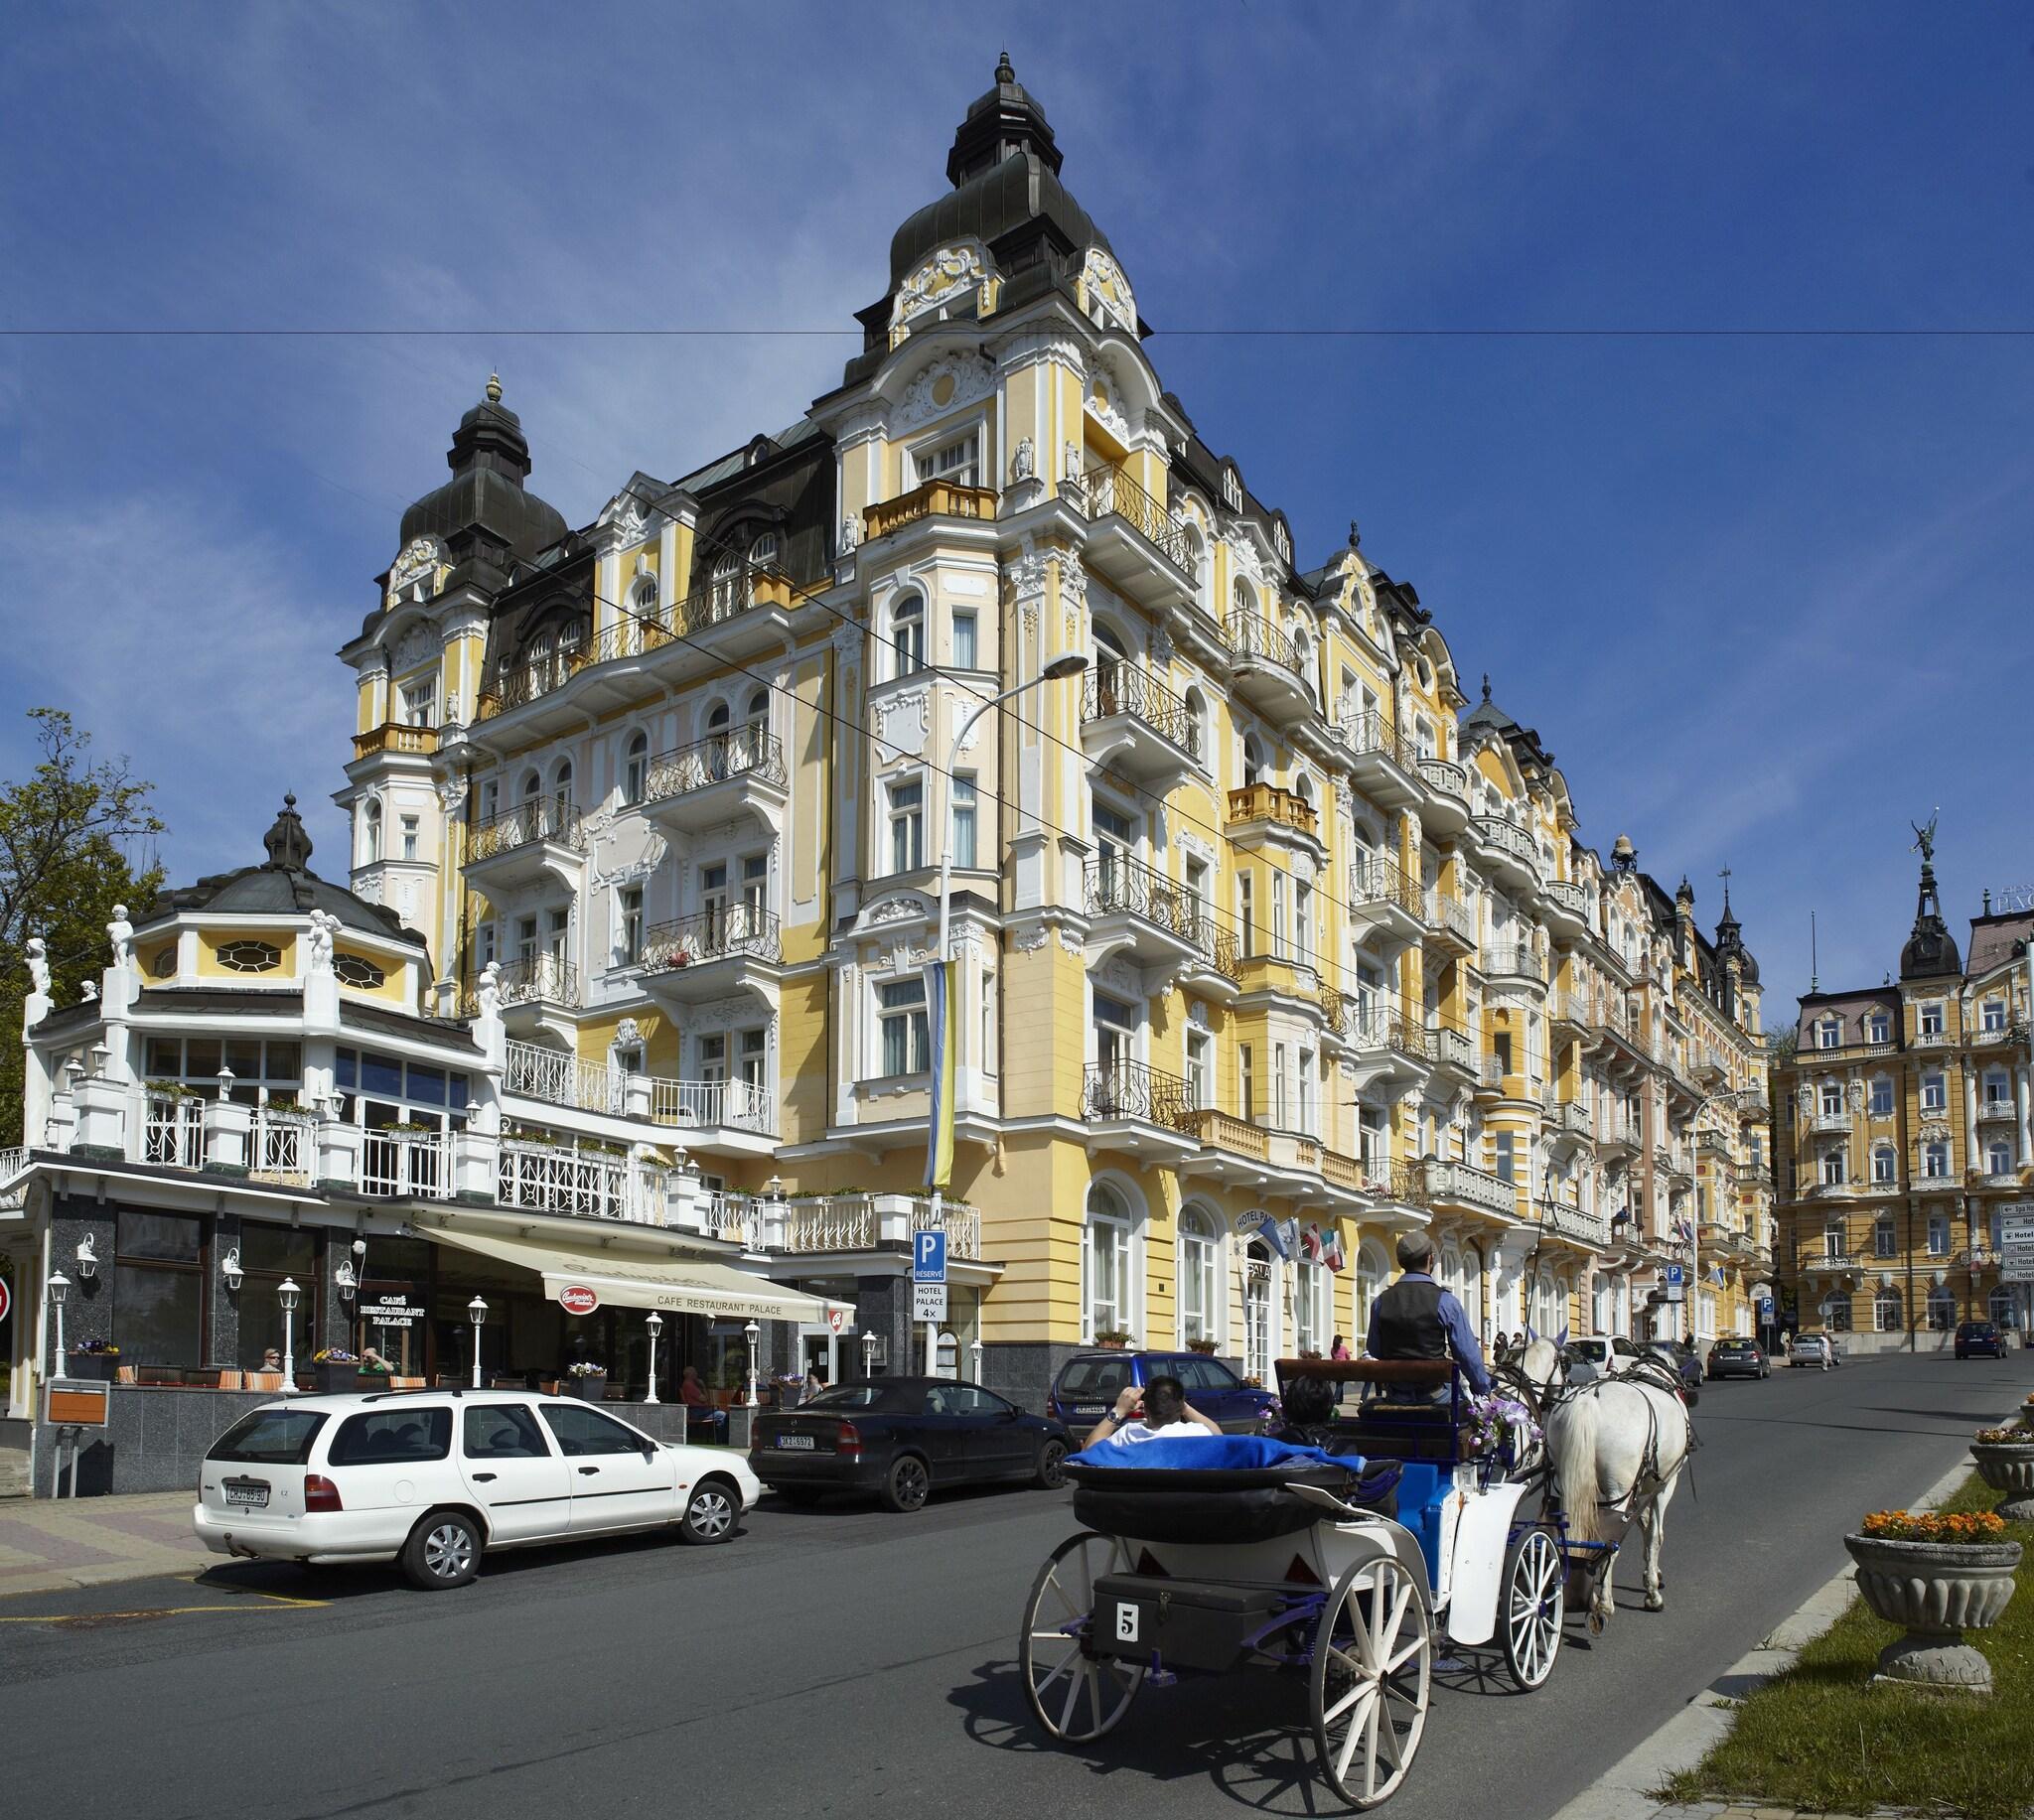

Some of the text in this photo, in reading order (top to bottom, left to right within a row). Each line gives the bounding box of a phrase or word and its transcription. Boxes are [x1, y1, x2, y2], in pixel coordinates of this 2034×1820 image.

[1236, 1210, 1258, 1229] HOTEL
[922, 1235, 937, 1264] P
[360, 1305, 425, 1317] RESTAURANT
[657, 1295, 782, 1316] CAFE RESTAURANT PALACE
[372, 1316, 413, 1327] PALACE
[1121, 1610, 1133, 1634] 5
